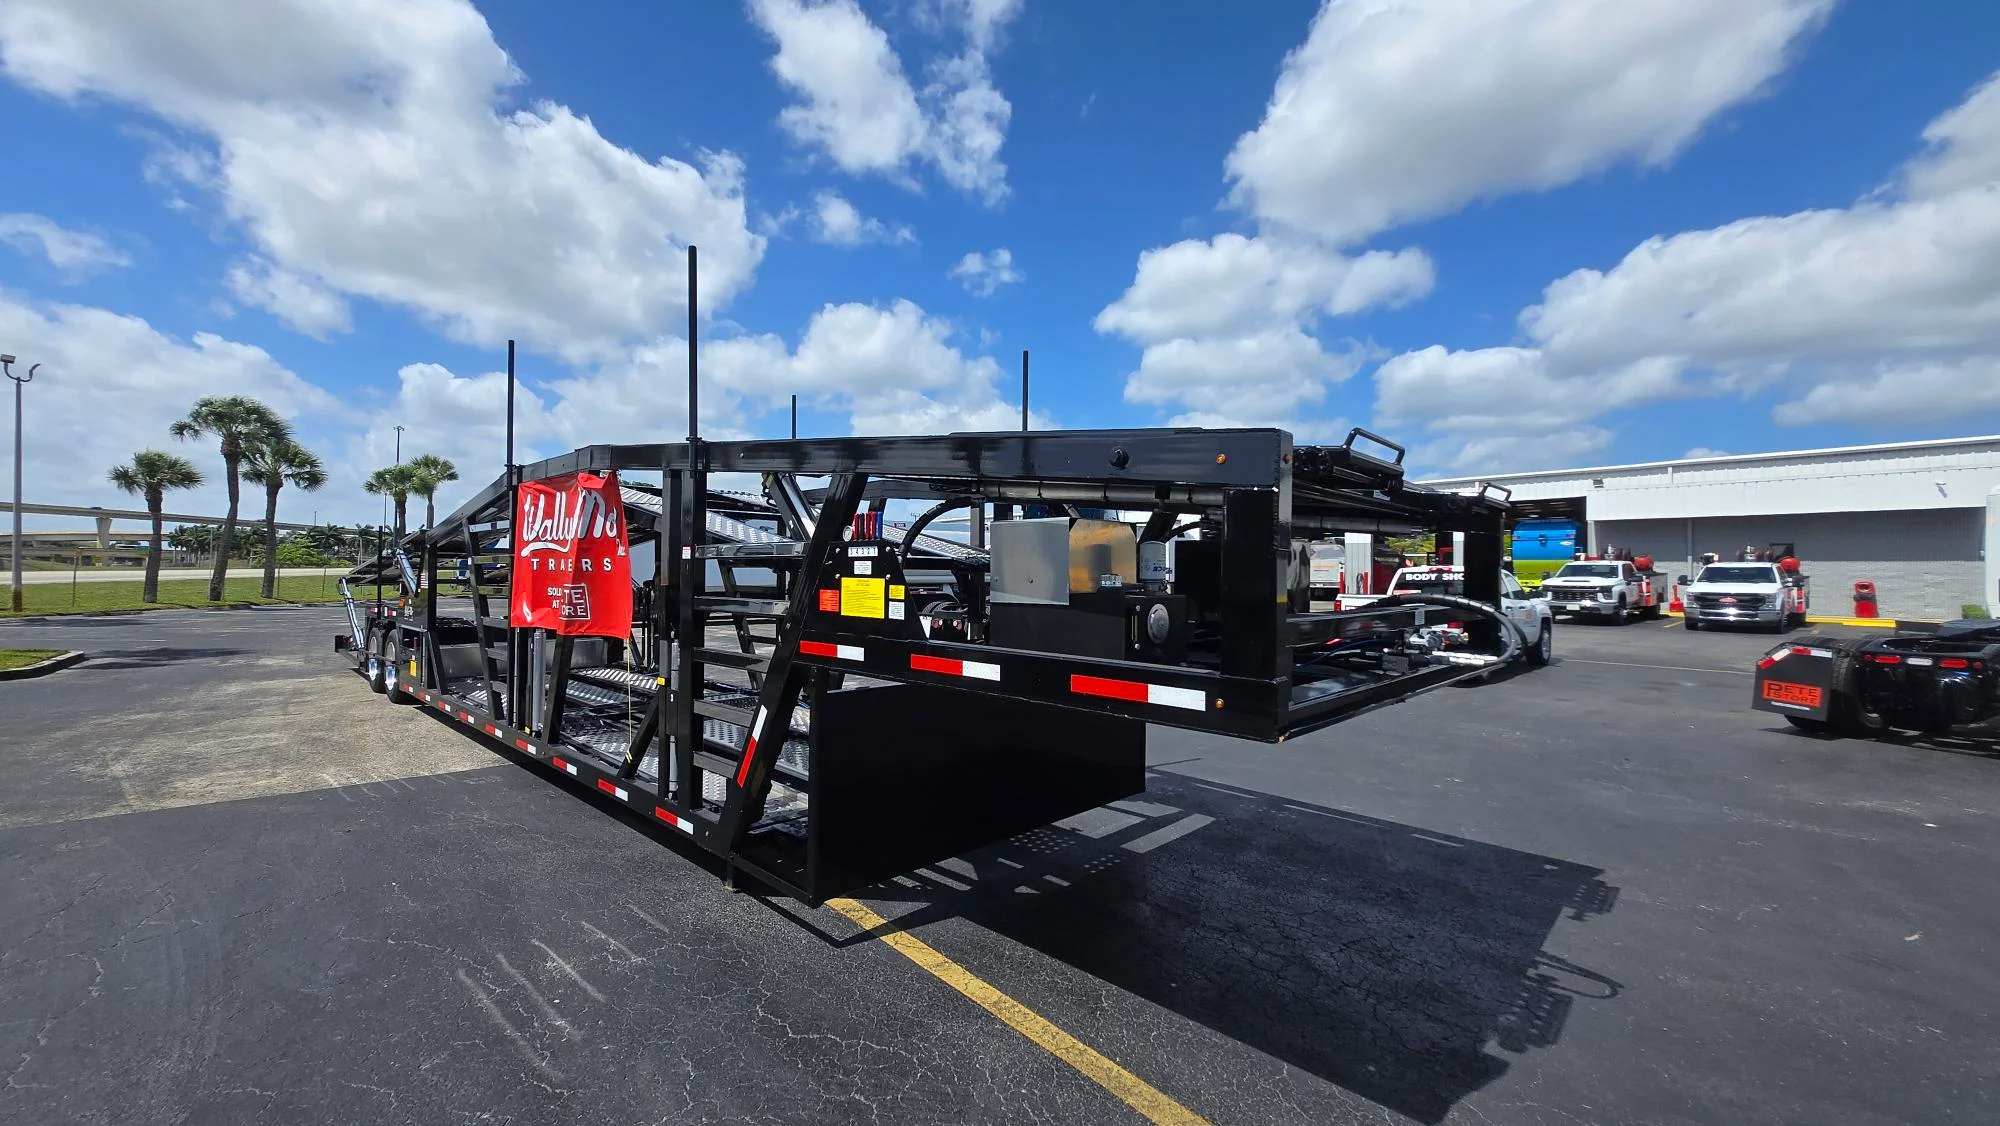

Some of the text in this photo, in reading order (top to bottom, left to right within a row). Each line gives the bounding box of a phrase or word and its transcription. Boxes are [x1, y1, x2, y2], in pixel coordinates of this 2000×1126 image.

[548, 587, 562, 596] SOLD
[552, 600, 560, 609] AT
[1766, 682, 1818, 698] PETE
[1774, 693, 1818, 704] STORE
